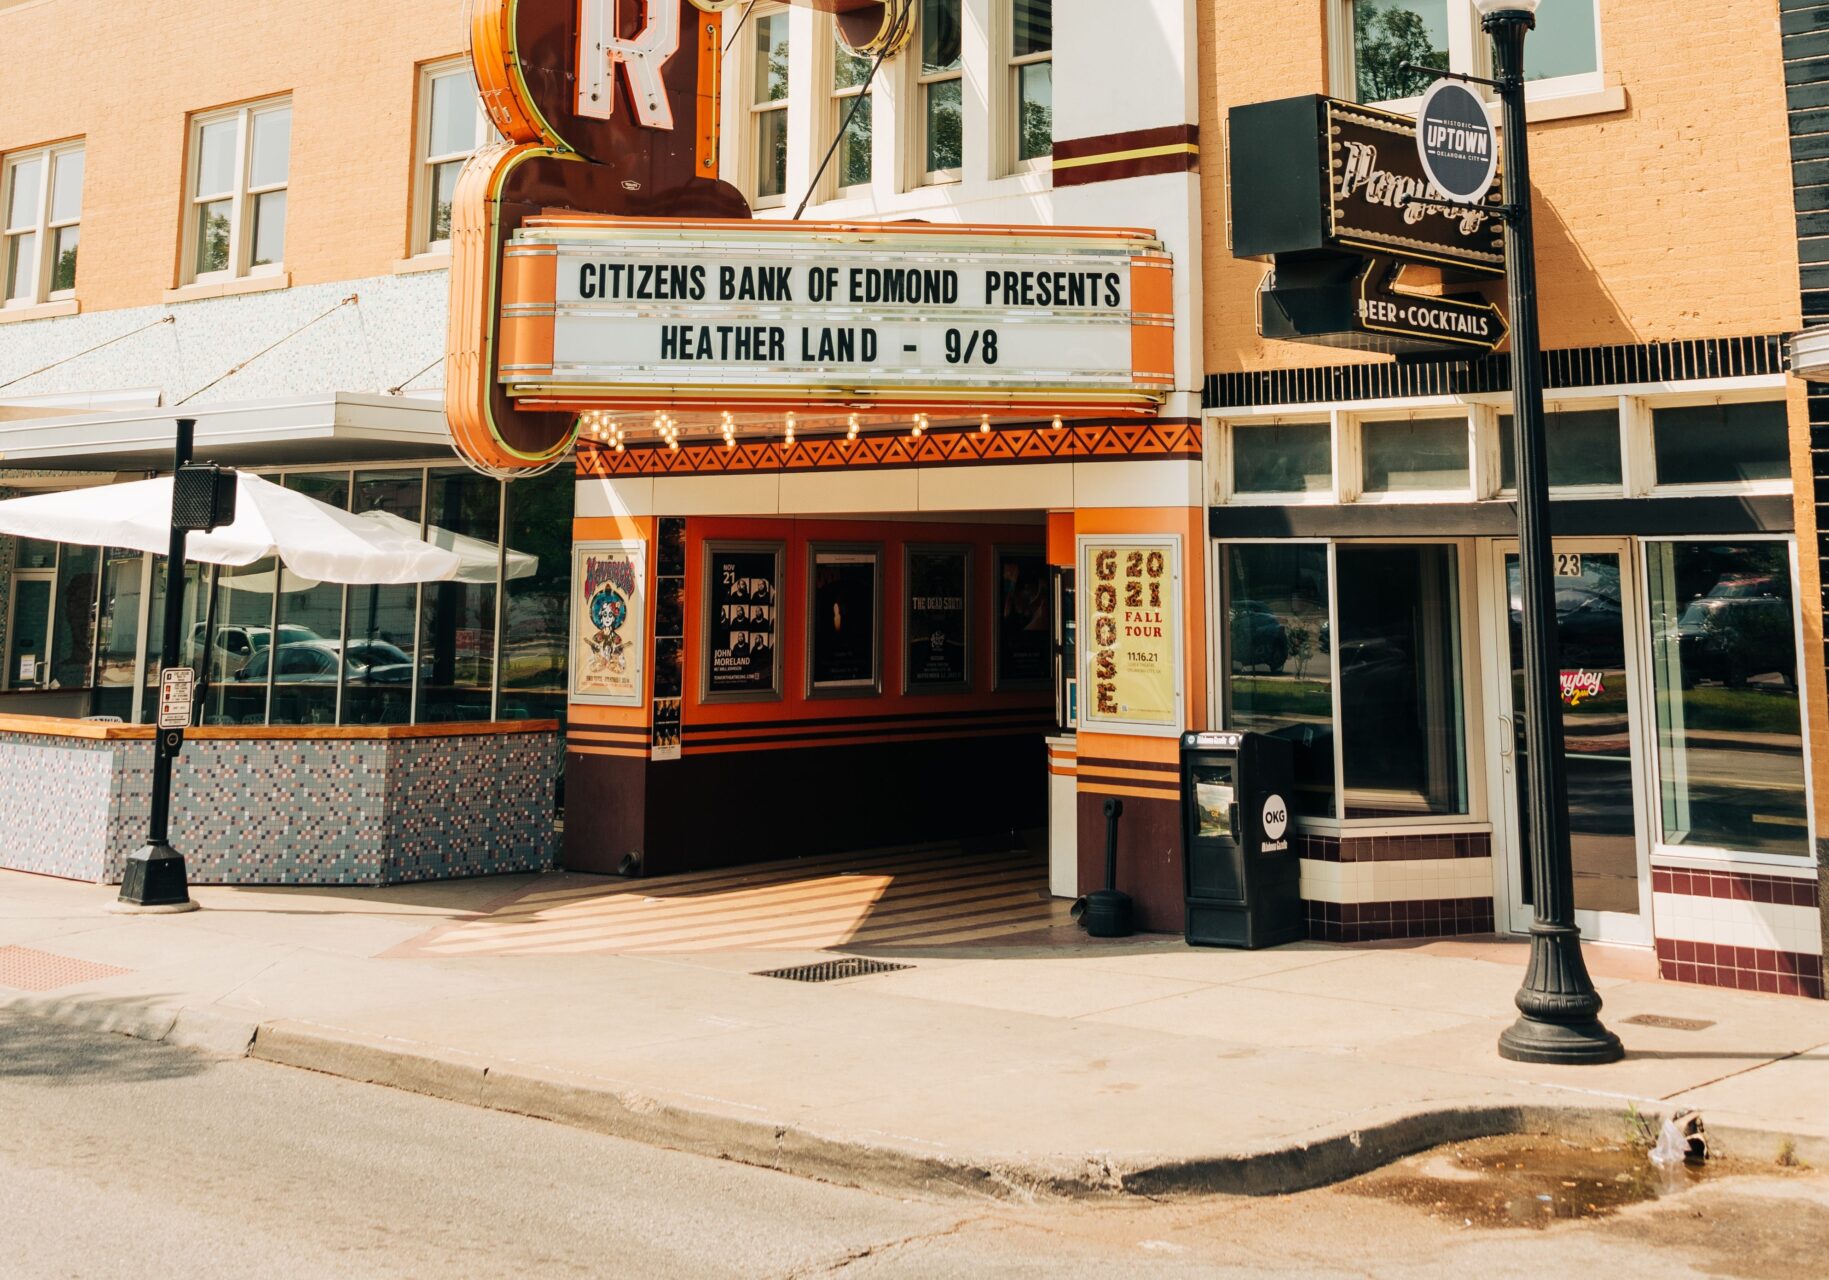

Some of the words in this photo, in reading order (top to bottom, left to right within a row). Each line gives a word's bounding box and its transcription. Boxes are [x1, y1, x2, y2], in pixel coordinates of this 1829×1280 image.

[1443, 119, 1472, 129] HISTORIC
[1427, 125, 1488, 155] UPTOWN
[1436, 150, 1466, 160] OKLAHOMA
[579, 263, 706, 301] CITIZENS
[719, 265, 792, 302] BANK
[808, 266, 839, 303] OF
[849, 268, 958, 304] EDMOND
[985, 270, 1121, 307] PRESENTS
[1358, 298, 1397, 322] BEER
[1407, 306, 1489, 336] COCKTAILS
[661, 325, 785, 362] HEATHER
[801, 327, 878, 362] LAND
[945, 328, 998, 365] 9/8
[1126, 551, 1164, 578] 20
[1555, 554, 1580, 576] 23
[723, 572, 736, 584] 21
[1125, 581, 1162, 608] 21
[912, 597, 926, 610] THE
[927, 597, 942, 610] DEAD
[1125, 611, 1163, 623] FALL
[1094, 549, 1119, 714] GOOSE
[1125, 626, 1163, 638] TOUR
[714, 649, 732, 658] JOHN
[1127, 651, 1158, 662] 11.16.21
[714, 657, 750, 666] MORELAND
[1560, 668, 1602, 696] nyboy
[1265, 810, 1285, 824] OKG
